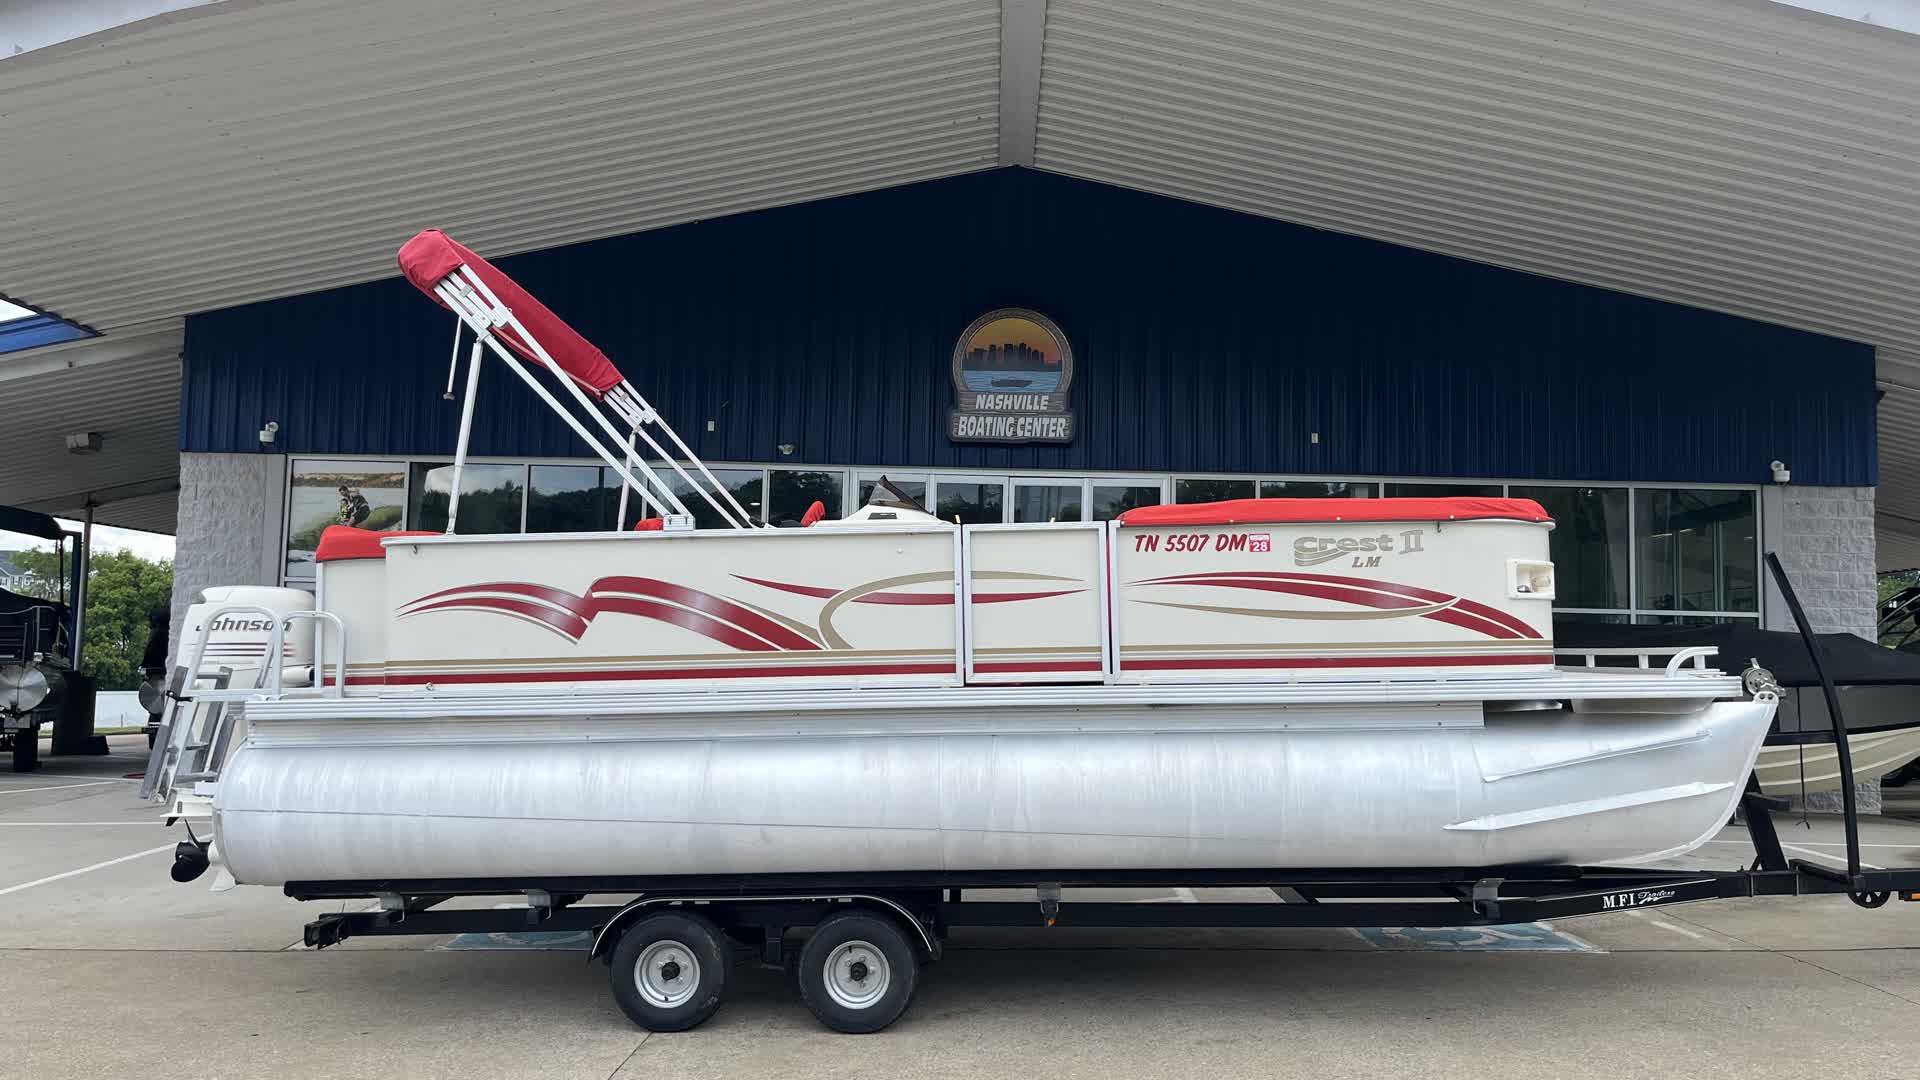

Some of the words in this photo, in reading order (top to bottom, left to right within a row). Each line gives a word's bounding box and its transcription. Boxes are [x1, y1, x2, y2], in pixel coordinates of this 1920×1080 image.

[975, 394, 1049, 410] NASHVILLE
[958, 416, 1015, 437] BOATING
[1017, 417, 1066, 438] CENTER
[1135, 534, 1160, 553] TN
[1164, 534, 1210, 552] 5507
[1215, 533, 1248, 552] DM
[1252, 541, 1268, 552] 28
[1398, 529, 1424, 555] II
[1351, 556, 1382, 568] LM
